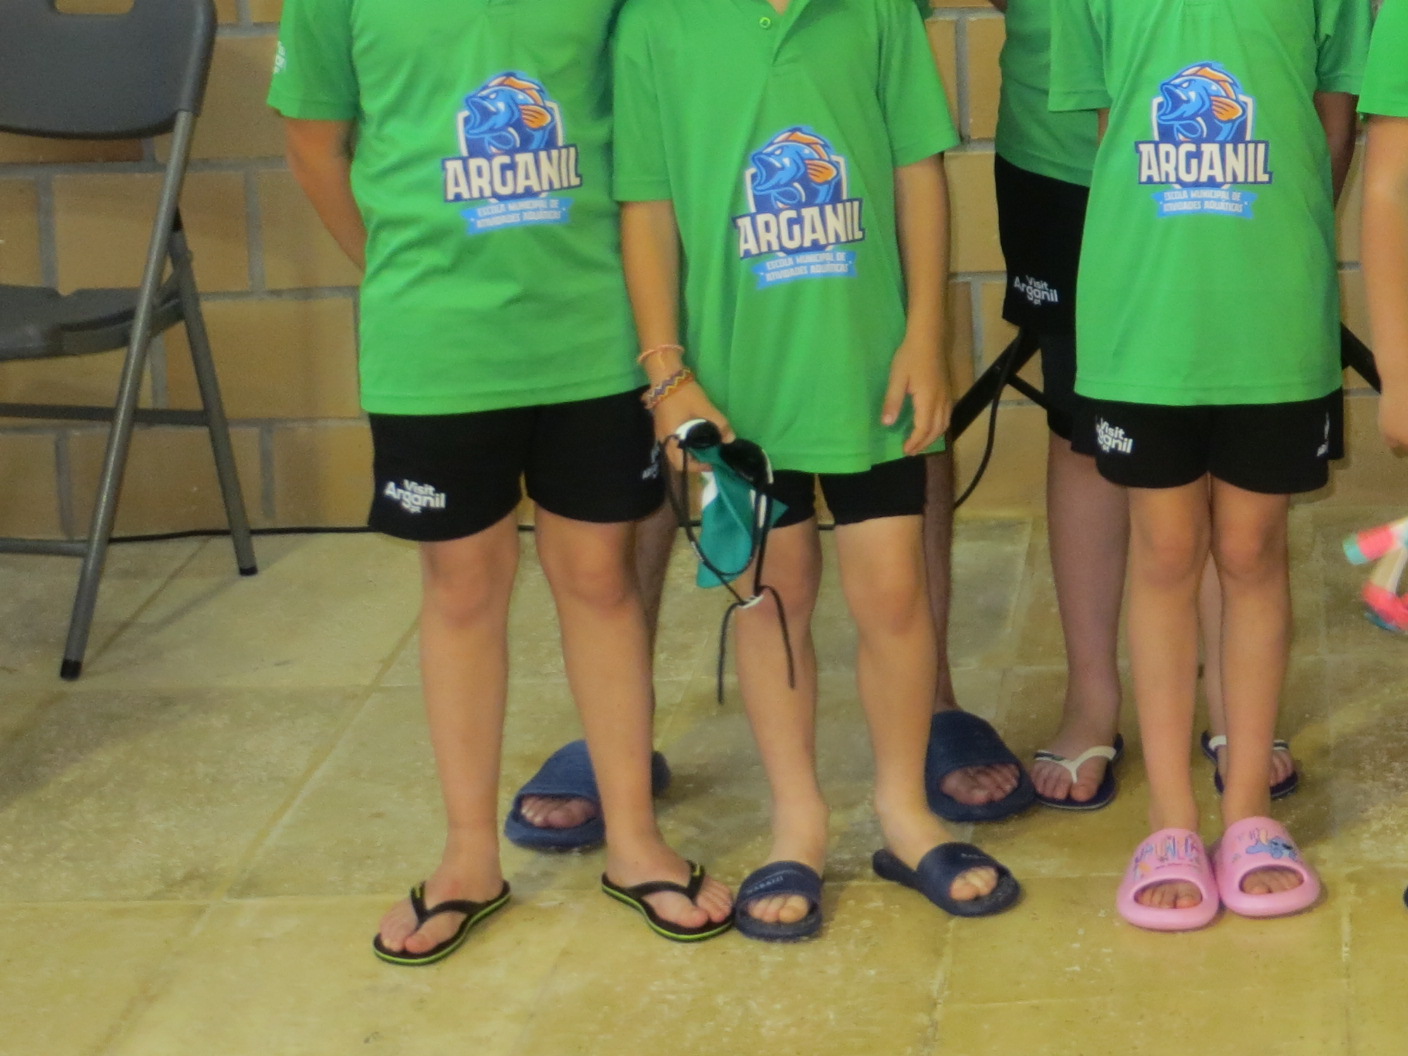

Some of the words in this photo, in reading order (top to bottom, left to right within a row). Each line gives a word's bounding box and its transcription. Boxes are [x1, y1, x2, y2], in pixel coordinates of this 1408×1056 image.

[444, 146, 582, 201] ARGANIL
[1137, 142, 1270, 183] ARGANIL
[735, 200, 864, 258] ARGANIL
